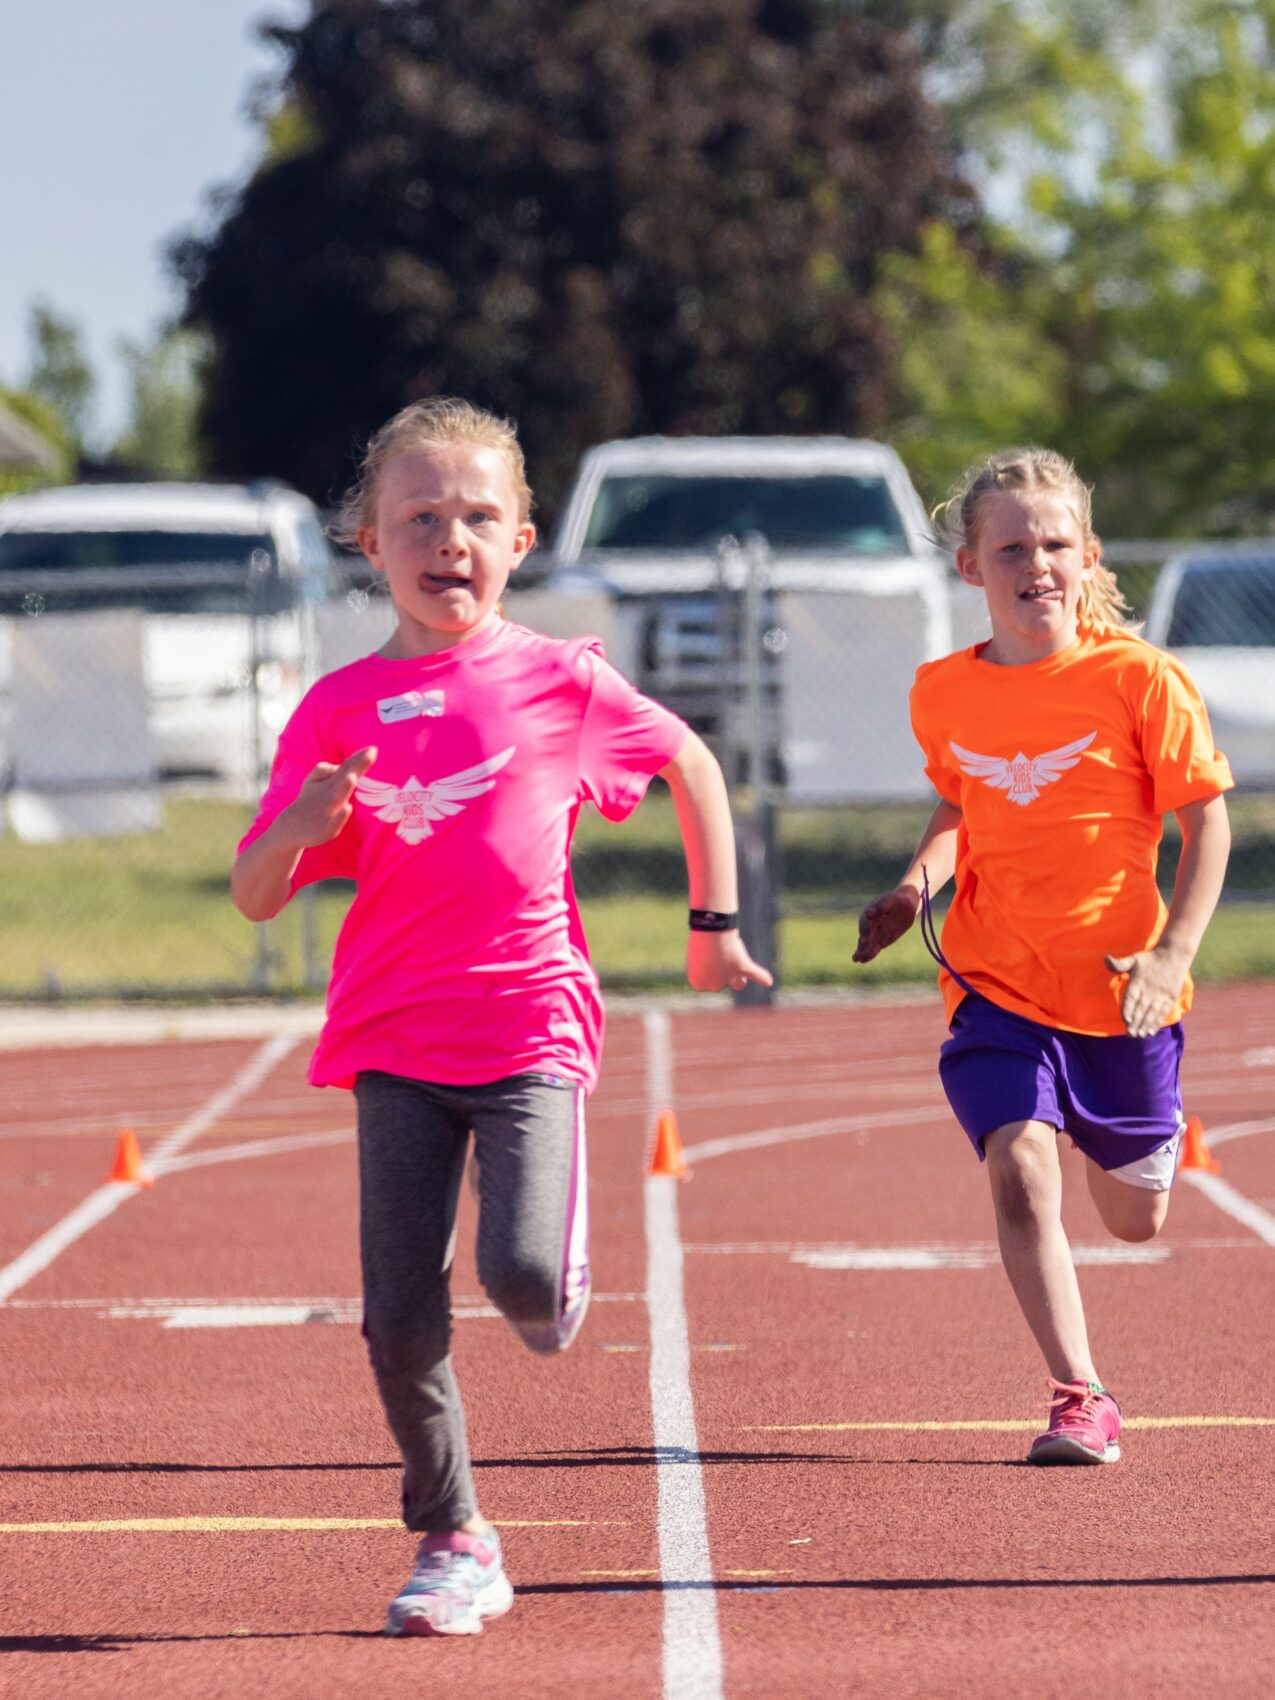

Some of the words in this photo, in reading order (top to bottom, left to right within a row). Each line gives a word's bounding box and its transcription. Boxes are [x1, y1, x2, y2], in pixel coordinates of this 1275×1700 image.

[1006, 762, 1037, 773] VELOCITY
[1013, 773, 1031, 783] KIDS
[1012, 784, 1033, 794] CLUB
[402, 804, 424, 816] KIDS
